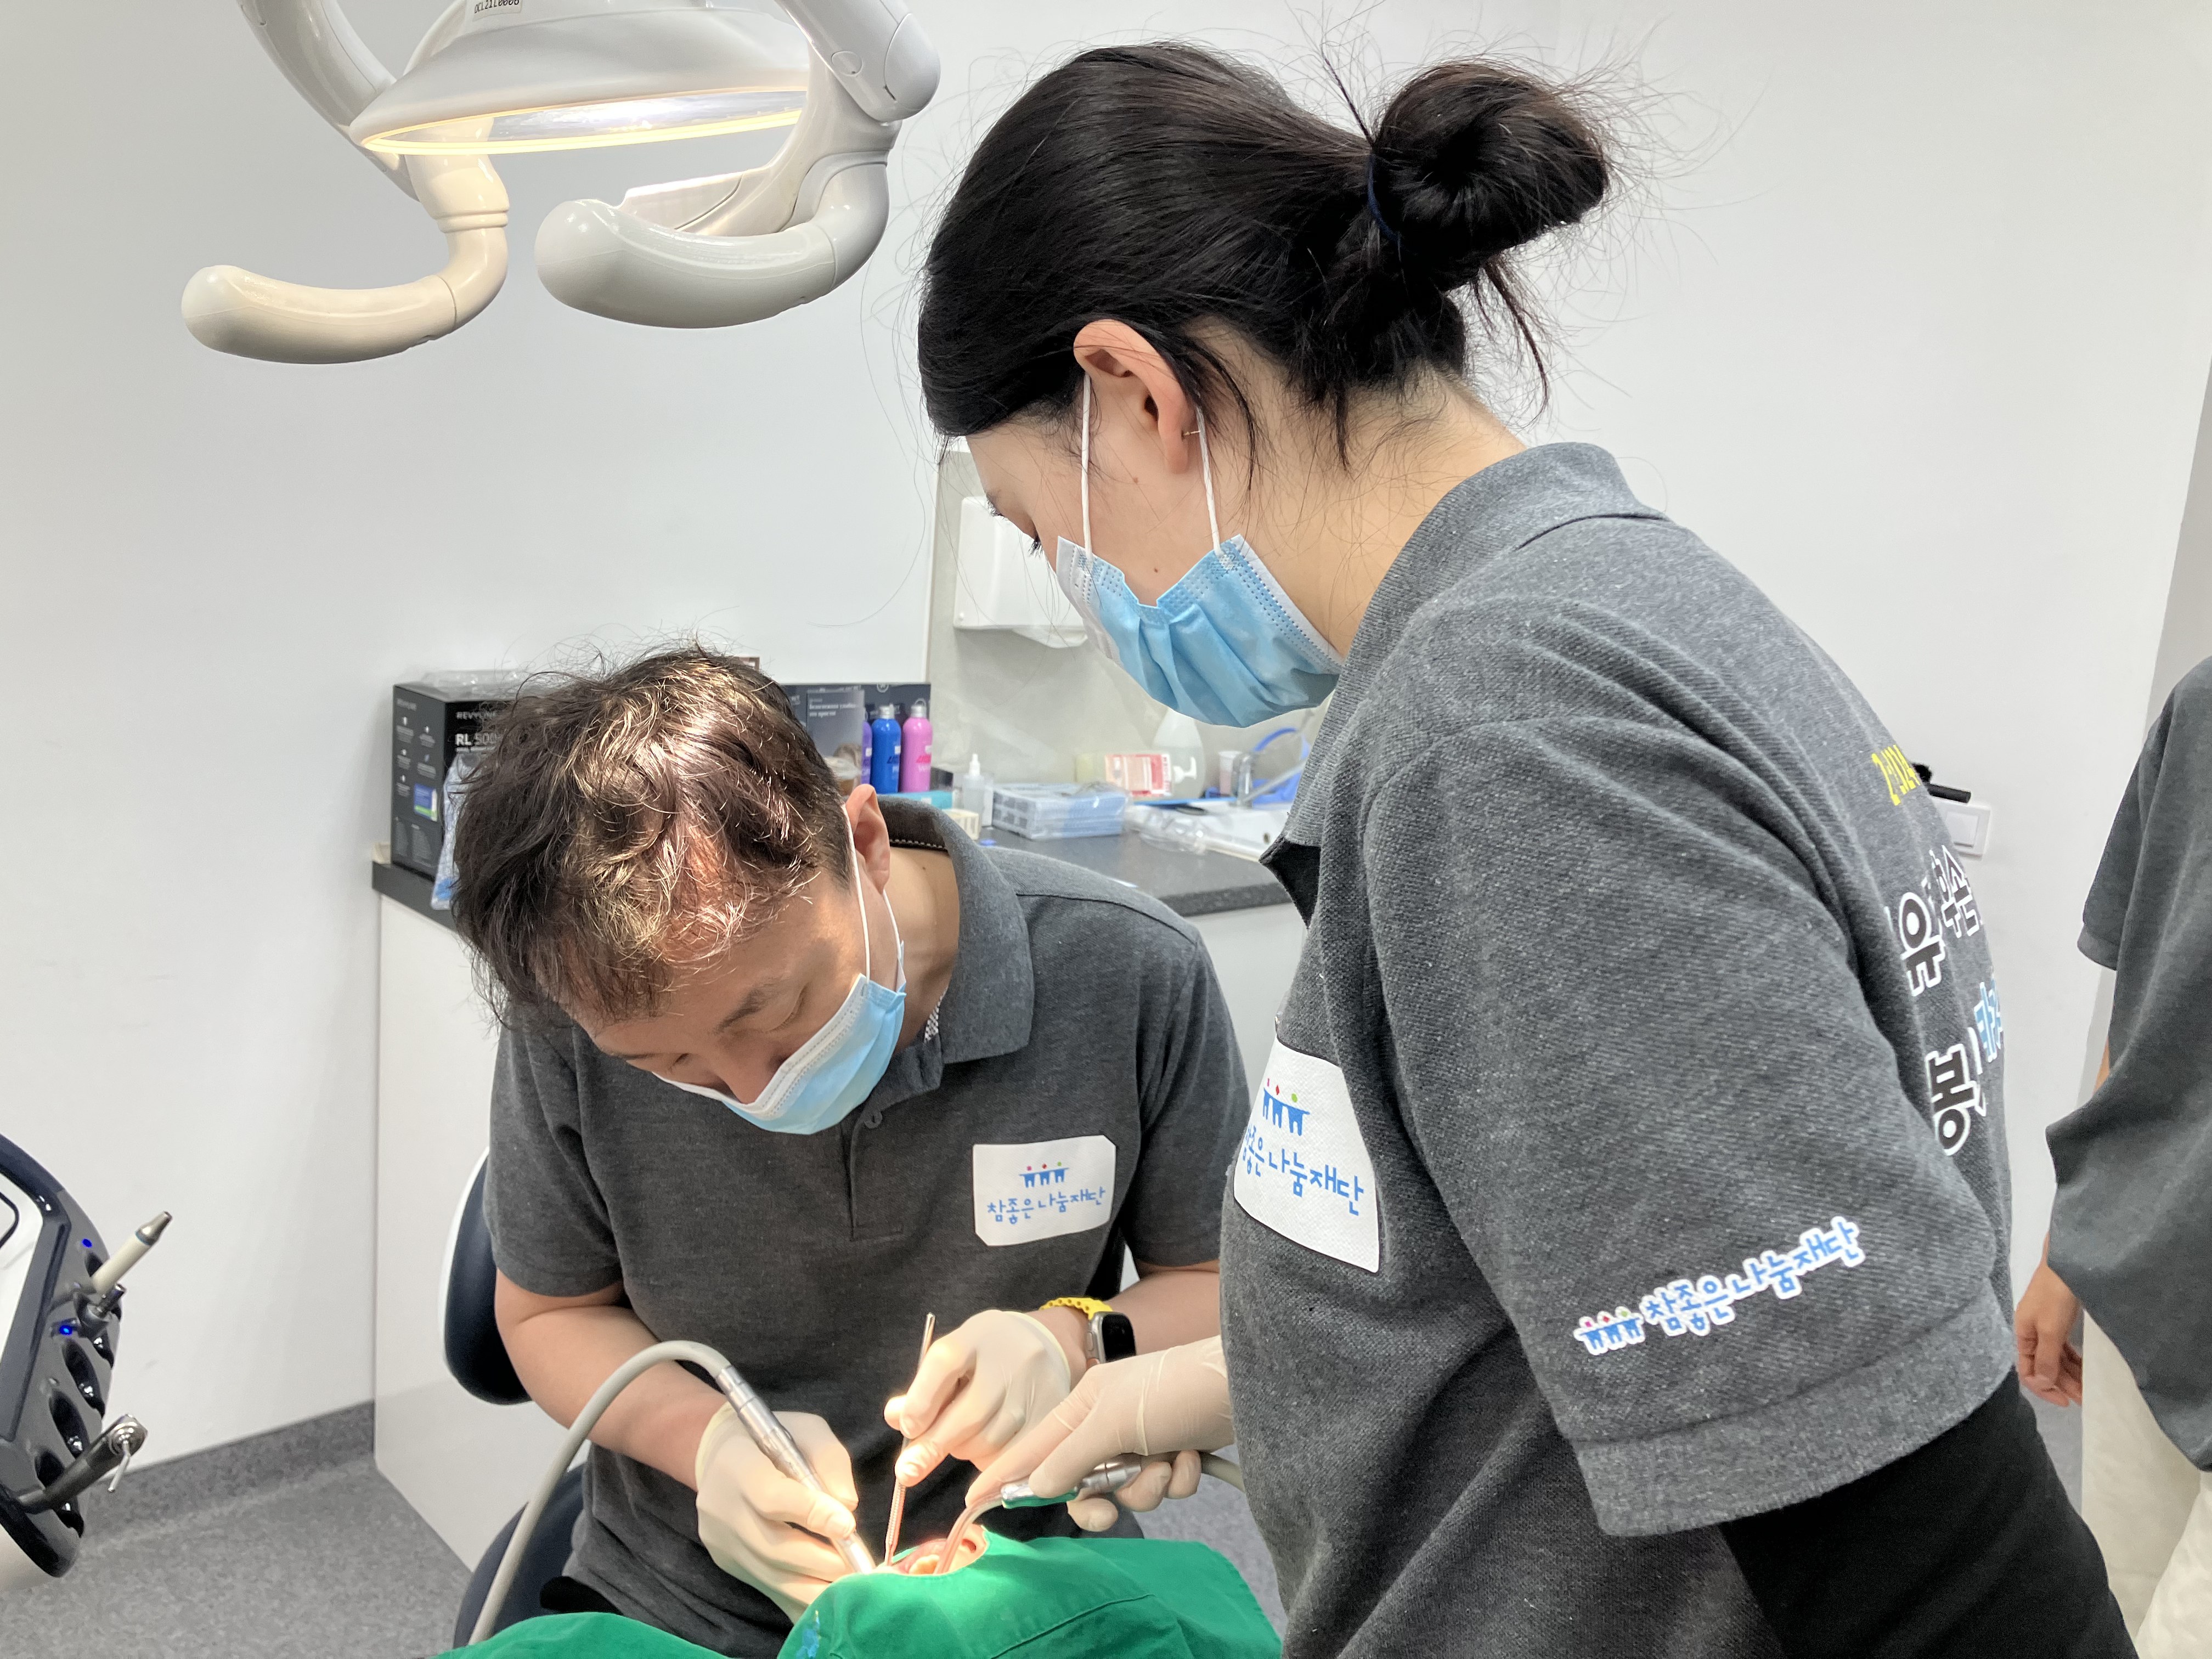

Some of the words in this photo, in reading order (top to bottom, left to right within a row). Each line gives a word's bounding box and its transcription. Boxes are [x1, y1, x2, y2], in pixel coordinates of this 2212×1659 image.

[455, 733, 472, 746] RL
[987, 1186, 1106, 1225] 참좋은나눔재단
[1640, 1218, 1864, 1335] 참좋은나눔재단
